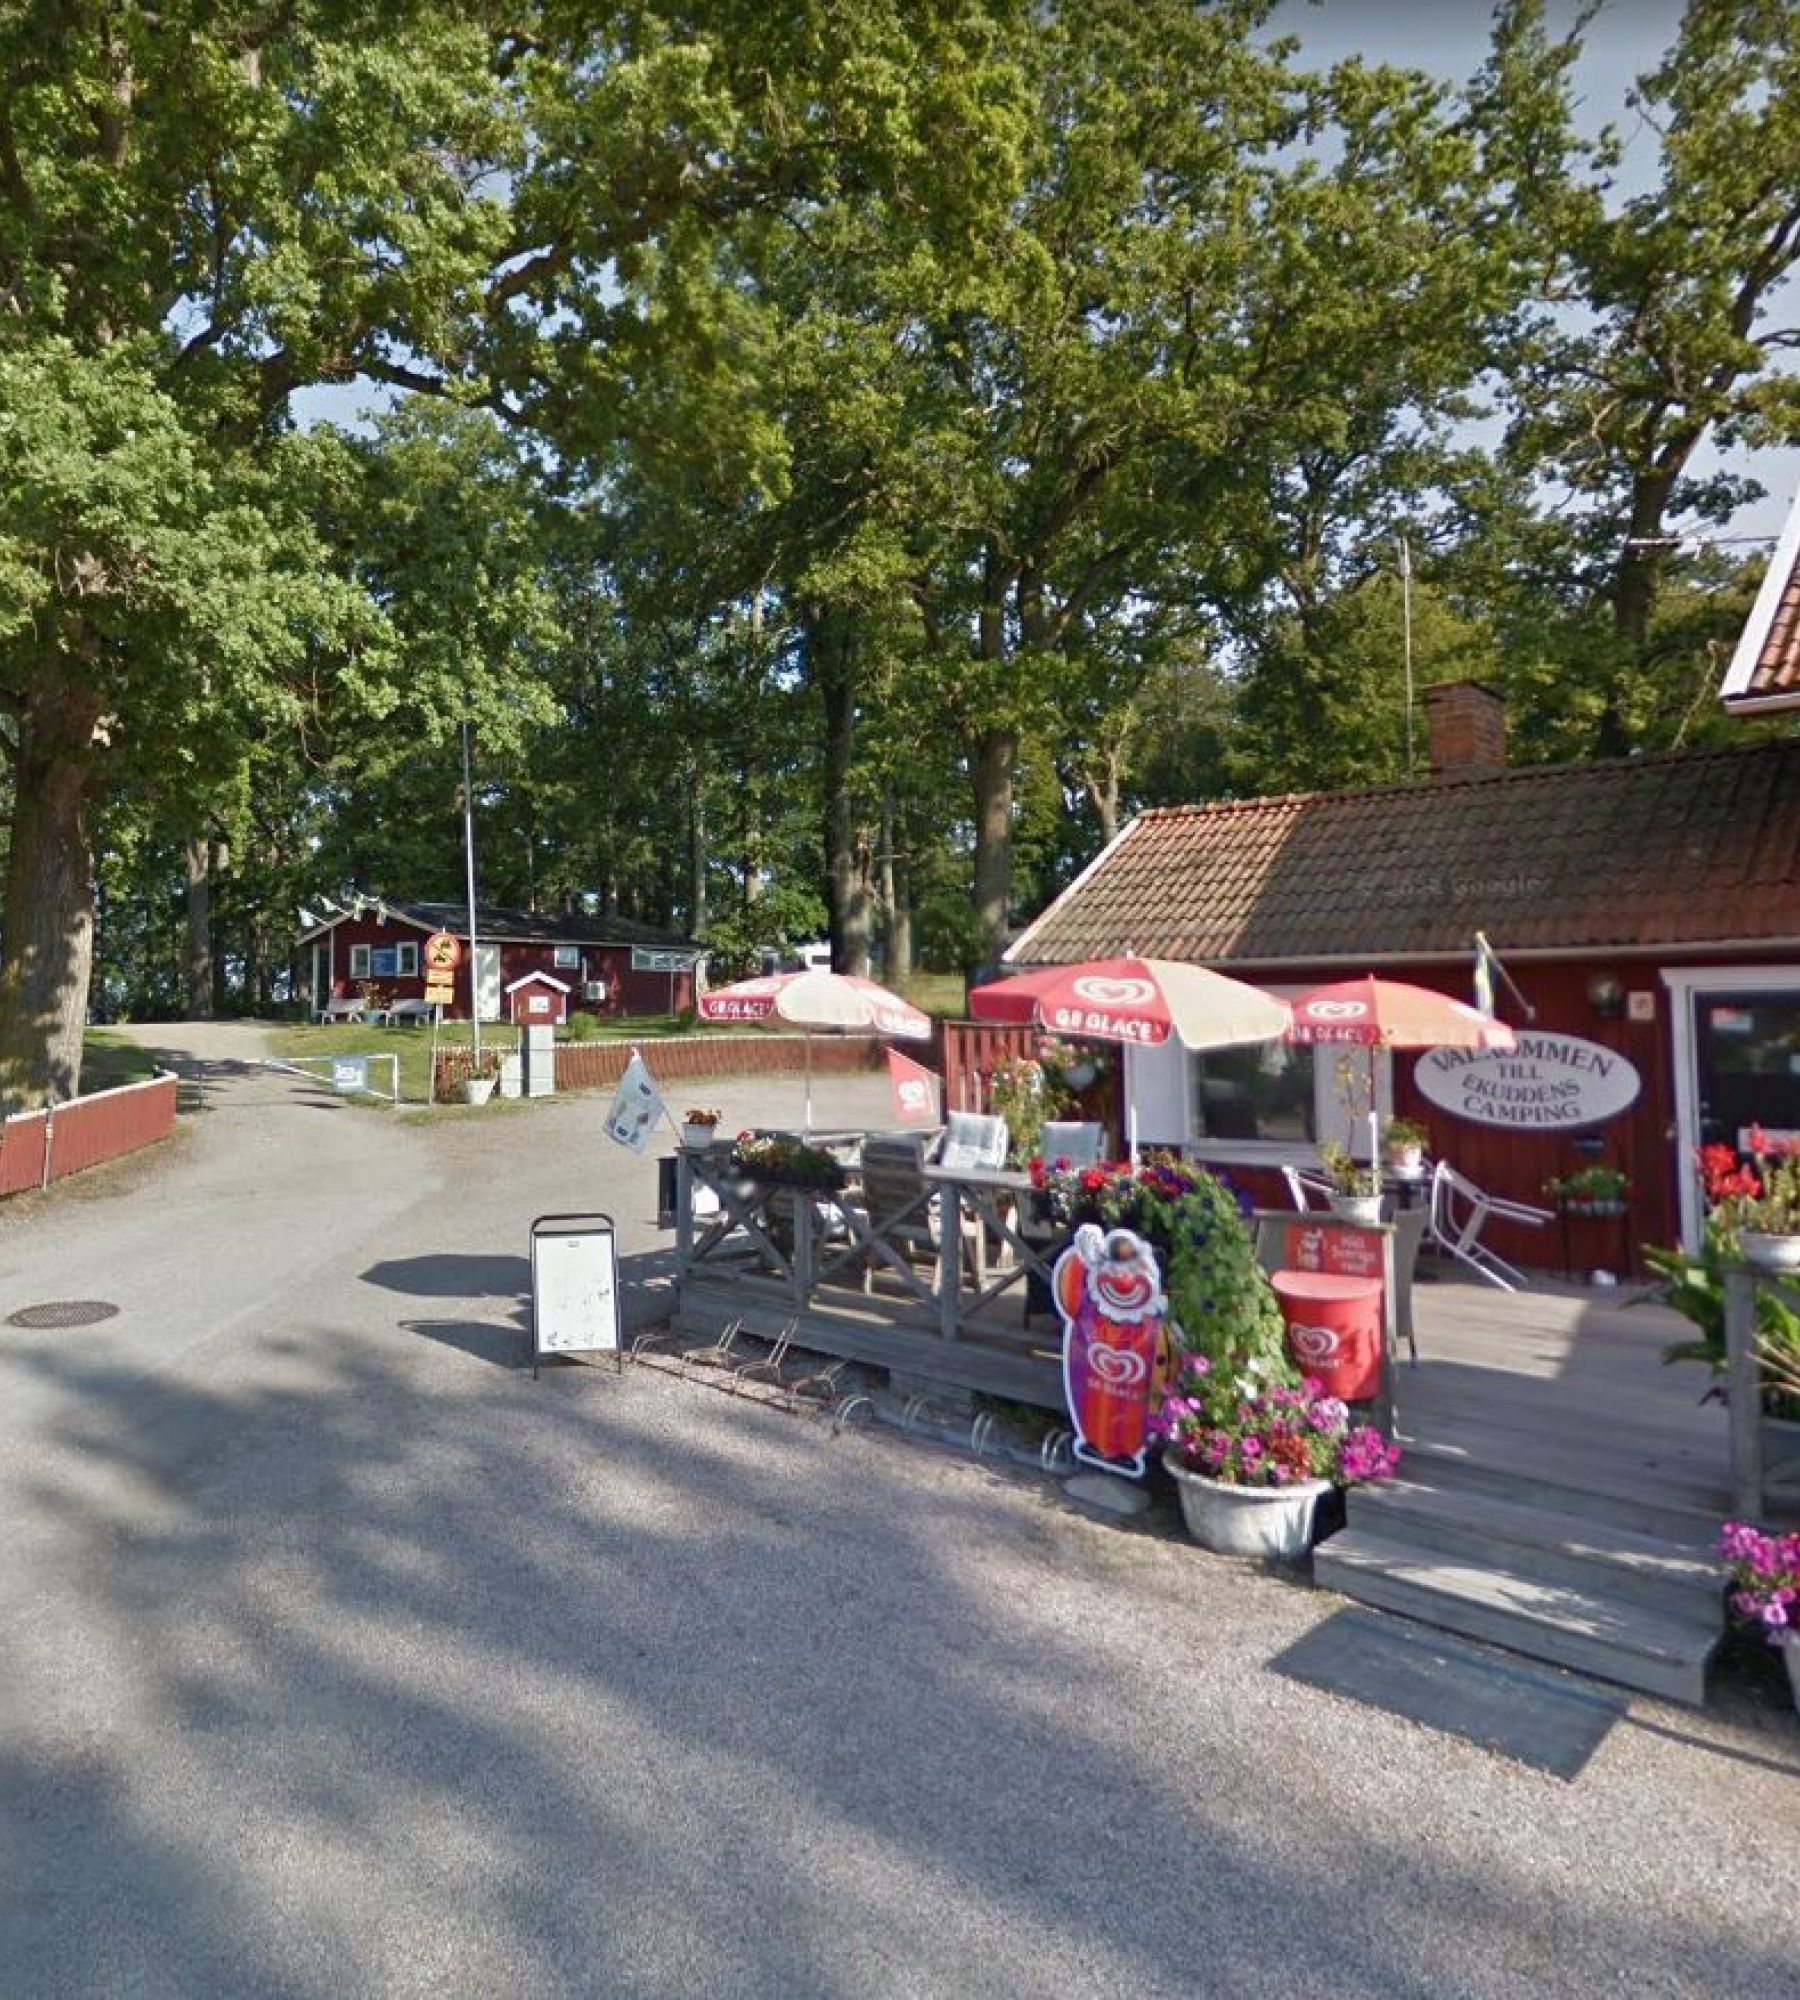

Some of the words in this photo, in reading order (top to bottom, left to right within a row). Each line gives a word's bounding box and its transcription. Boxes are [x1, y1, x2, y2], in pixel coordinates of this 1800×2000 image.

[1055, 1007, 1083, 1029] GB
[1085, 1011, 1151, 1039] GLACE
[1431, 1038, 1613, 1078] VALMMEN
[1497, 1061, 1543, 1080] TILL
[1461, 1072, 1581, 1101] EKUDDENS
[1463, 1095, 1581, 1123] CAMPING
